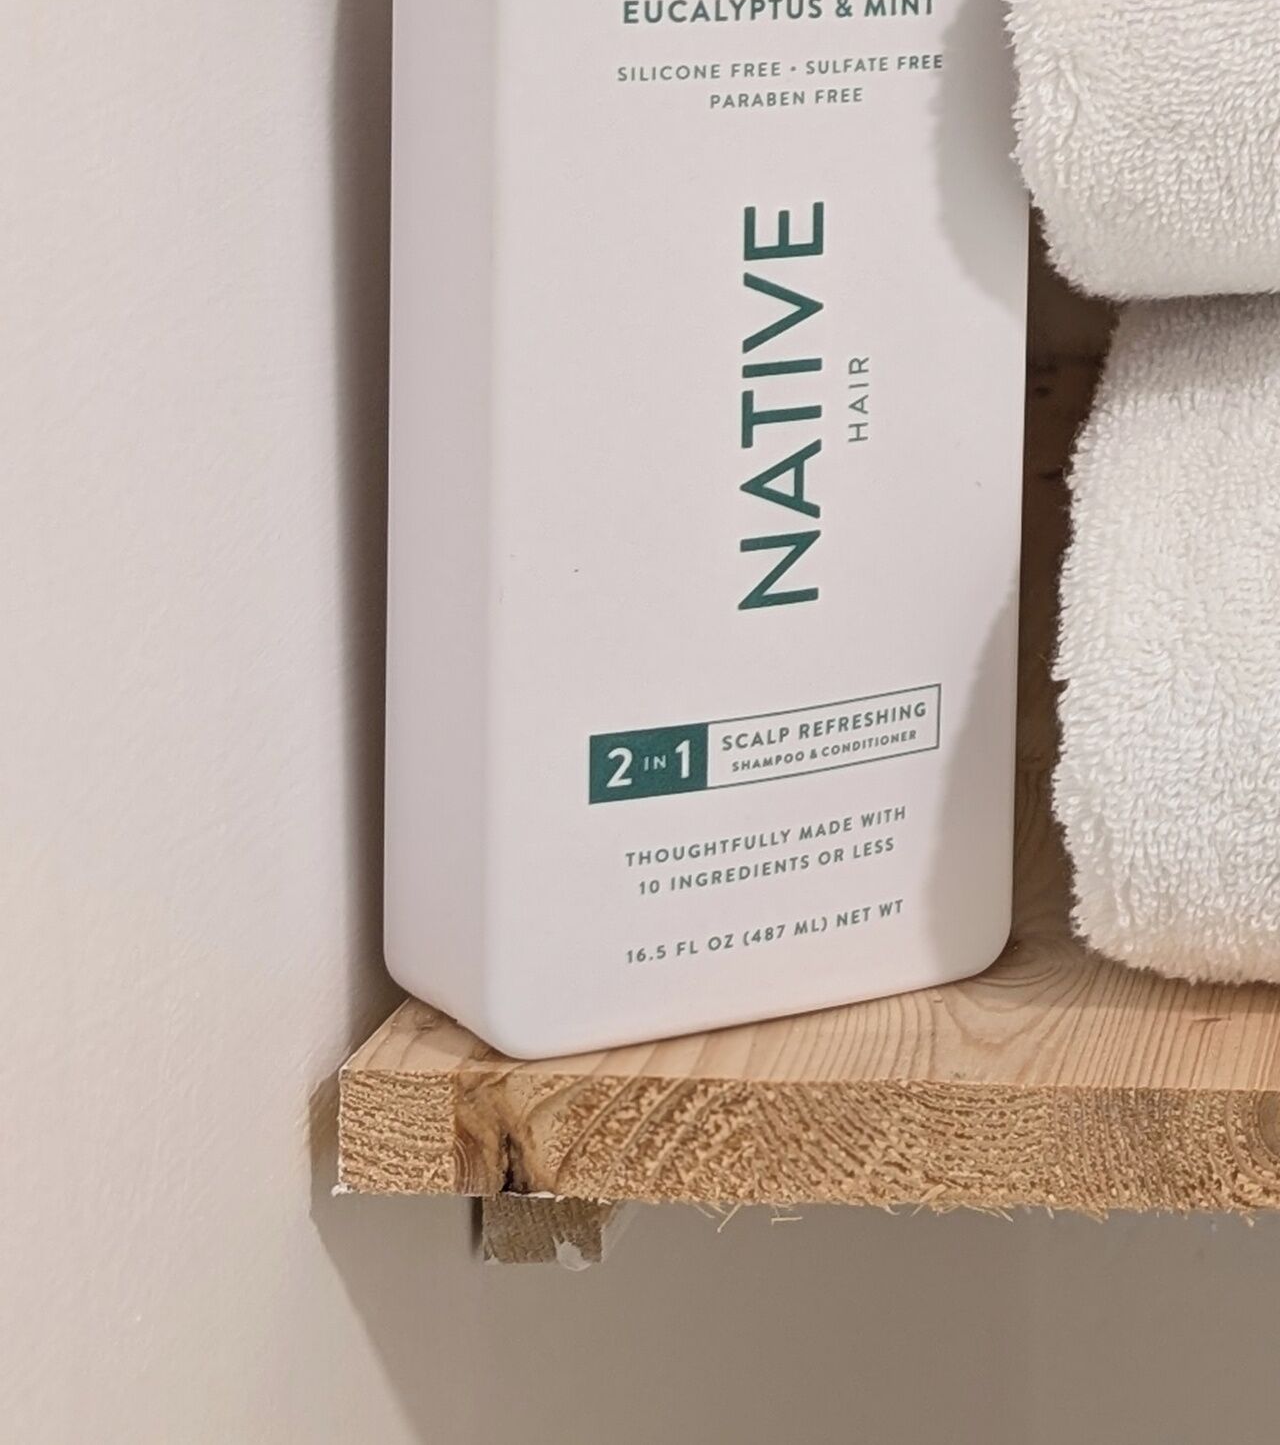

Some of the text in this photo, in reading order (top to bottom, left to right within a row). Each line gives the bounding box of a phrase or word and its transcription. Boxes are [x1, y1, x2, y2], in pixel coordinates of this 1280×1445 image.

[617, 53, 944, 82] SILICONE FREE SULFATE FREE
[710, 87, 863, 109] PARABEN FREE
[737, 201, 825, 611] NATIVE
[847, 357, 870, 443] HAIR
[721, 701, 927, 752] SCALP REFRESHING
[731, 729, 917, 773] SHAMPOO & CONDITIONER
[606, 739, 690, 788] 2 IN 1
[625, 805, 906, 867] THOUGHTFULLY MADE WITH
[639, 836, 894, 895] 10 INGREDIENTS OR LESS
[626, 898, 904, 964] 16.5 FL OZ (487 ML) NET WT
